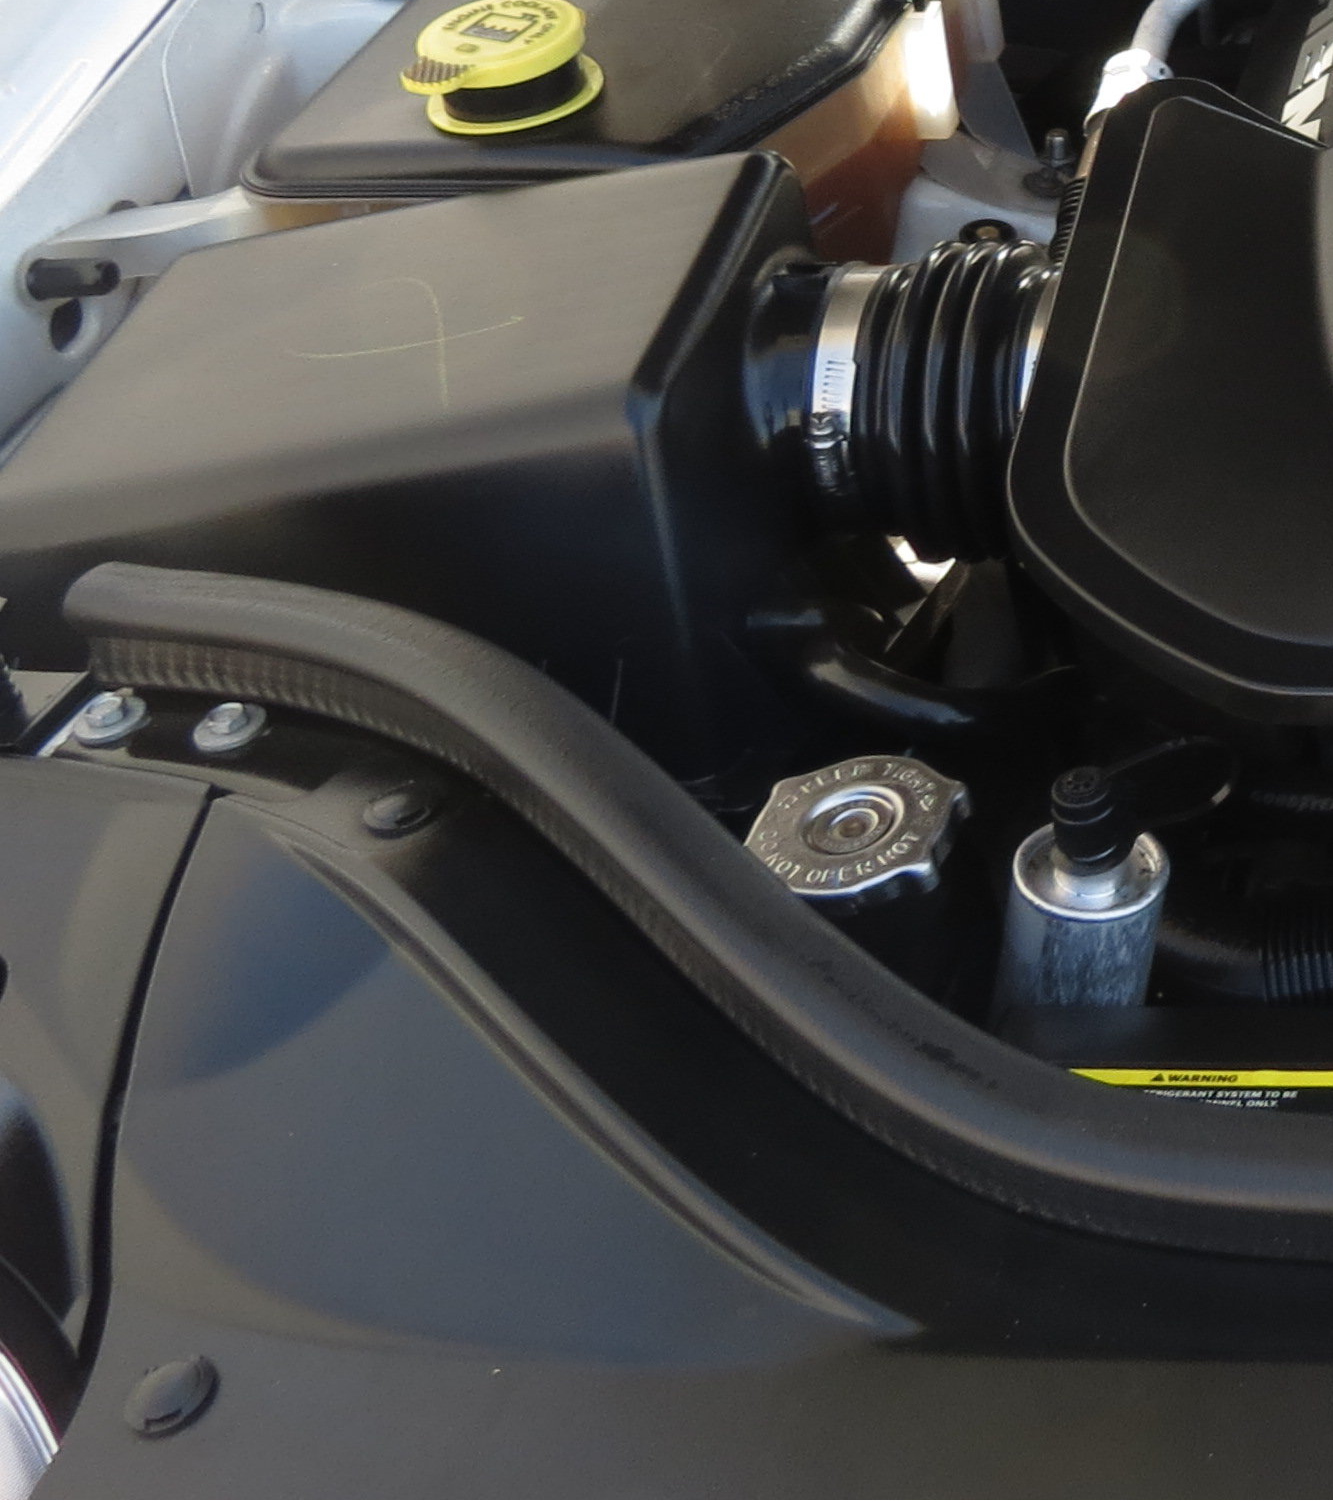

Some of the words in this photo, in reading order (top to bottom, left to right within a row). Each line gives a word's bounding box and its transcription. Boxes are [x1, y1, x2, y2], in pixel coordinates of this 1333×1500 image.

[1167, 1074, 1239, 1084] WARNING
[1215, 1090, 1263, 1098] SYSTEM
[1264, 1090, 1281, 1098] TO
[1281, 1090, 1299, 1098] BE
